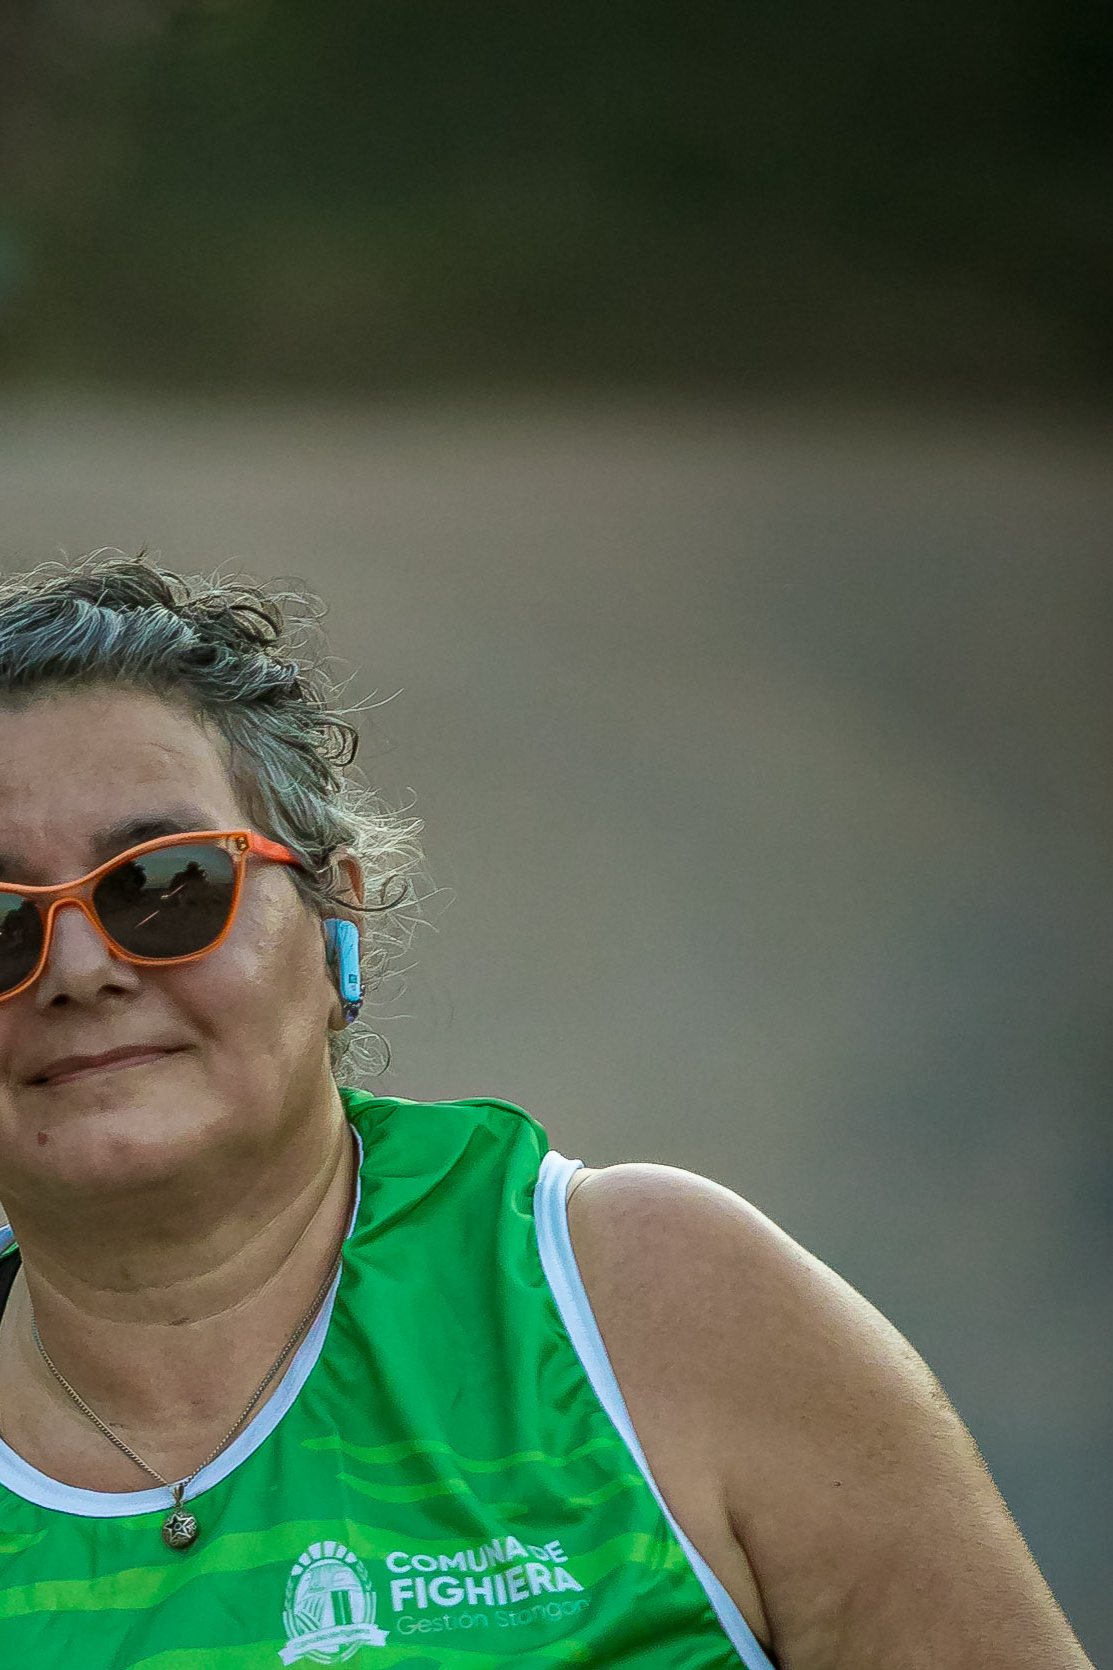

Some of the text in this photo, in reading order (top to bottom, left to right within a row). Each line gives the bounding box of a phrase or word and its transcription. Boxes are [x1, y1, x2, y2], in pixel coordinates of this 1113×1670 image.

[386, 1535, 569, 1574] COMUNA DE
[390, 1562, 584, 1612] FIGHIERA
